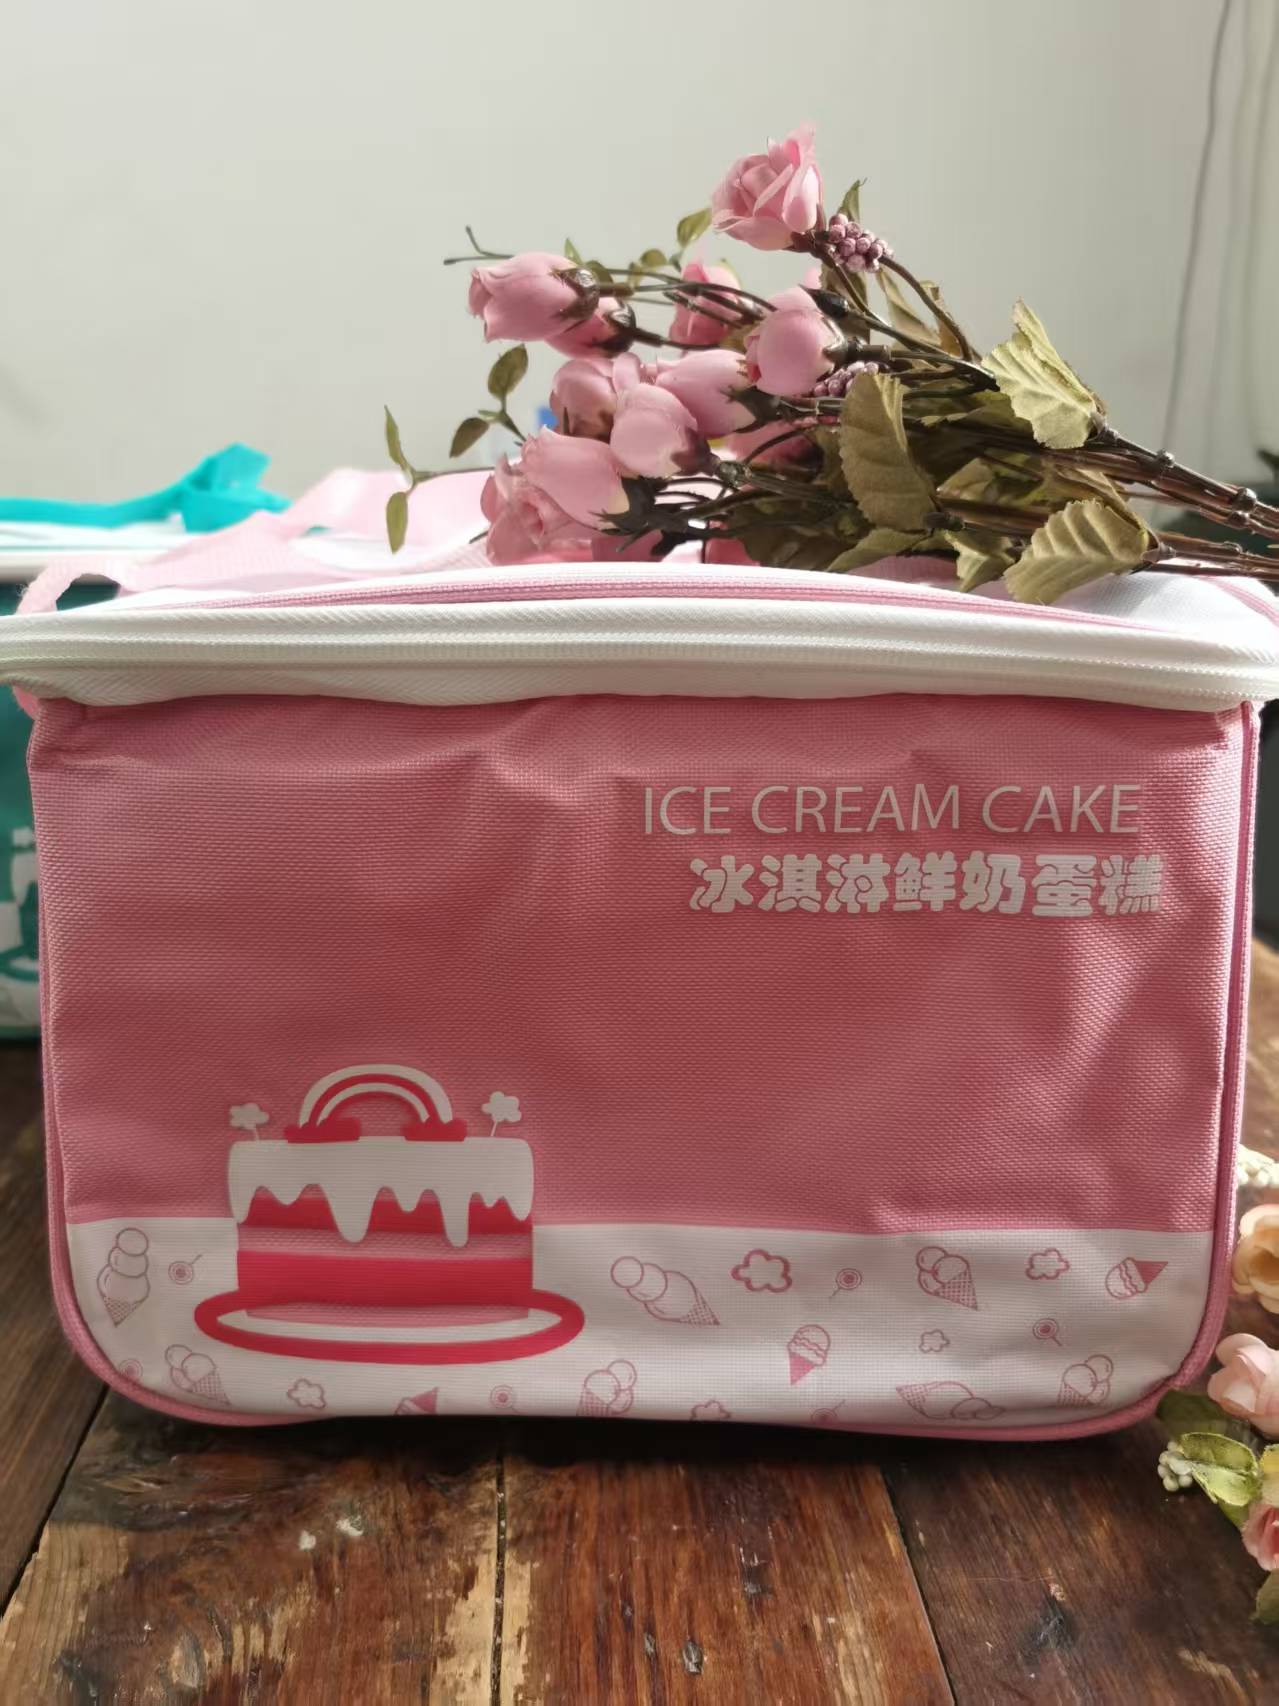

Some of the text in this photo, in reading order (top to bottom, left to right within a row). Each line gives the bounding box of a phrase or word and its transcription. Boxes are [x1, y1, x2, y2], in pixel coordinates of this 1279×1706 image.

[644, 784, 1142, 835] ICE CREAM CAKE
[689, 851, 1164, 917] 冰淇淋鲜奶蛋糕
